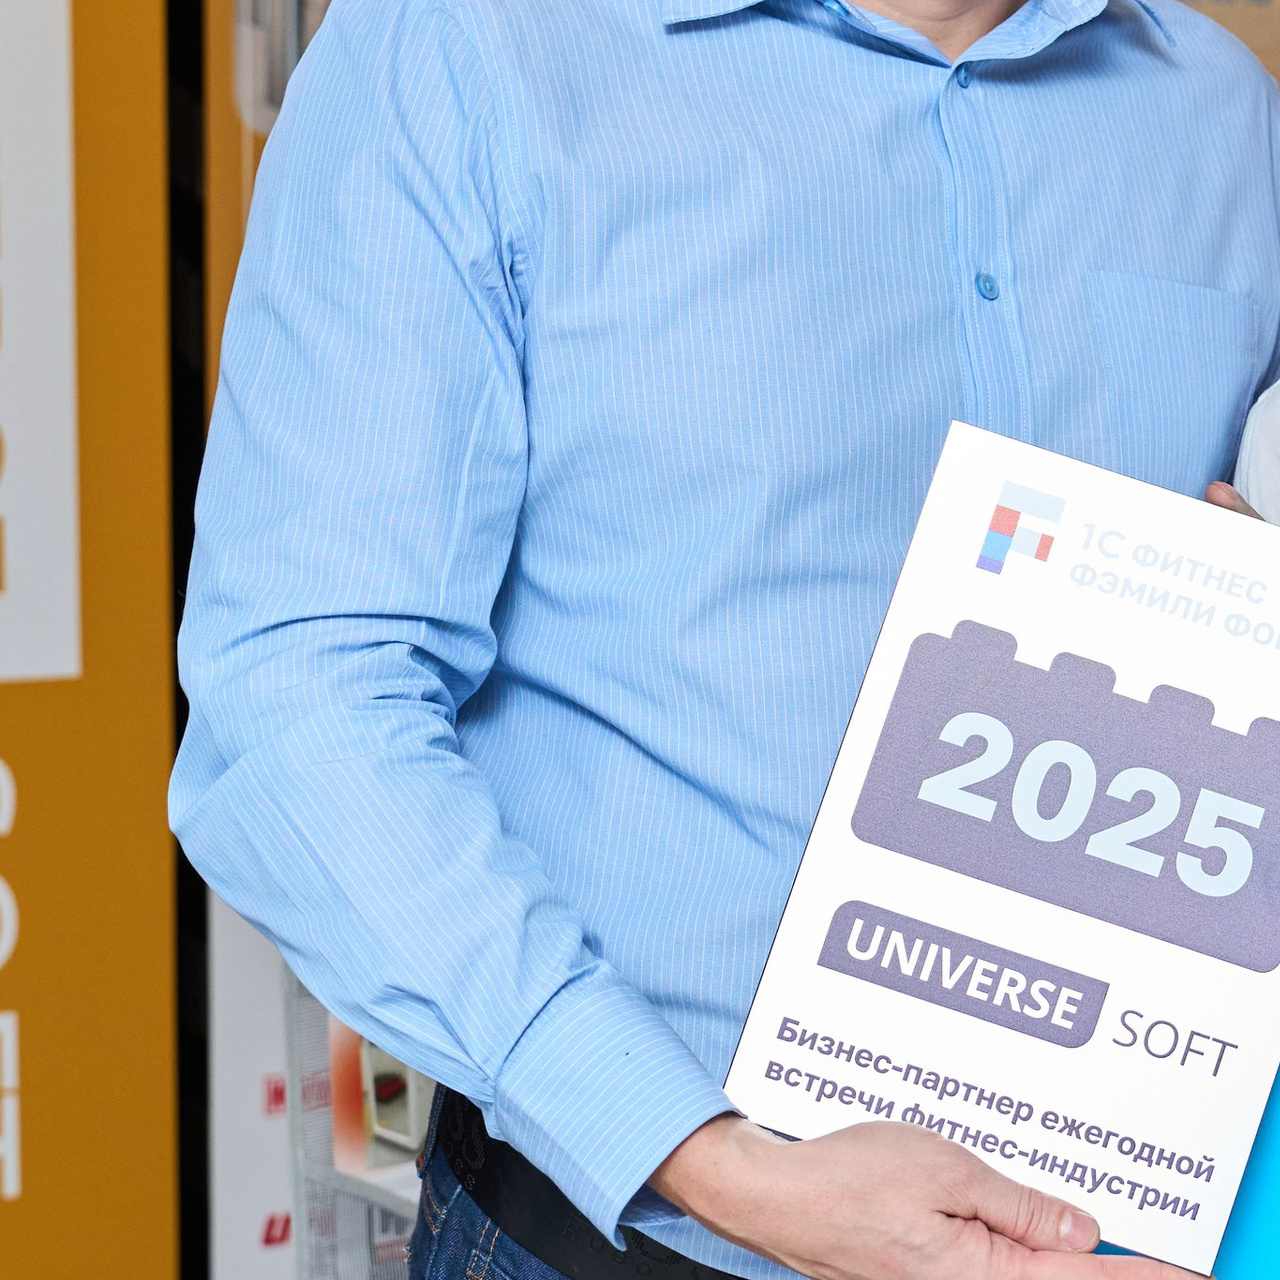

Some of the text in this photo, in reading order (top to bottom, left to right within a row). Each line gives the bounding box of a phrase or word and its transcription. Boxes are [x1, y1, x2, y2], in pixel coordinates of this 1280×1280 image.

[1068, 561, 1216, 629] ФЭМИЛИ
[1132, 542, 1269, 605] ФИТНЕС
[916, 711, 1266, 898] 2025
[845, 918, 1239, 1078] UNIVERSE SOFT
[764, 1059, 896, 1121] встречи
[775, 1016, 1216, 1184] Бизнес-партнер ежегодной
